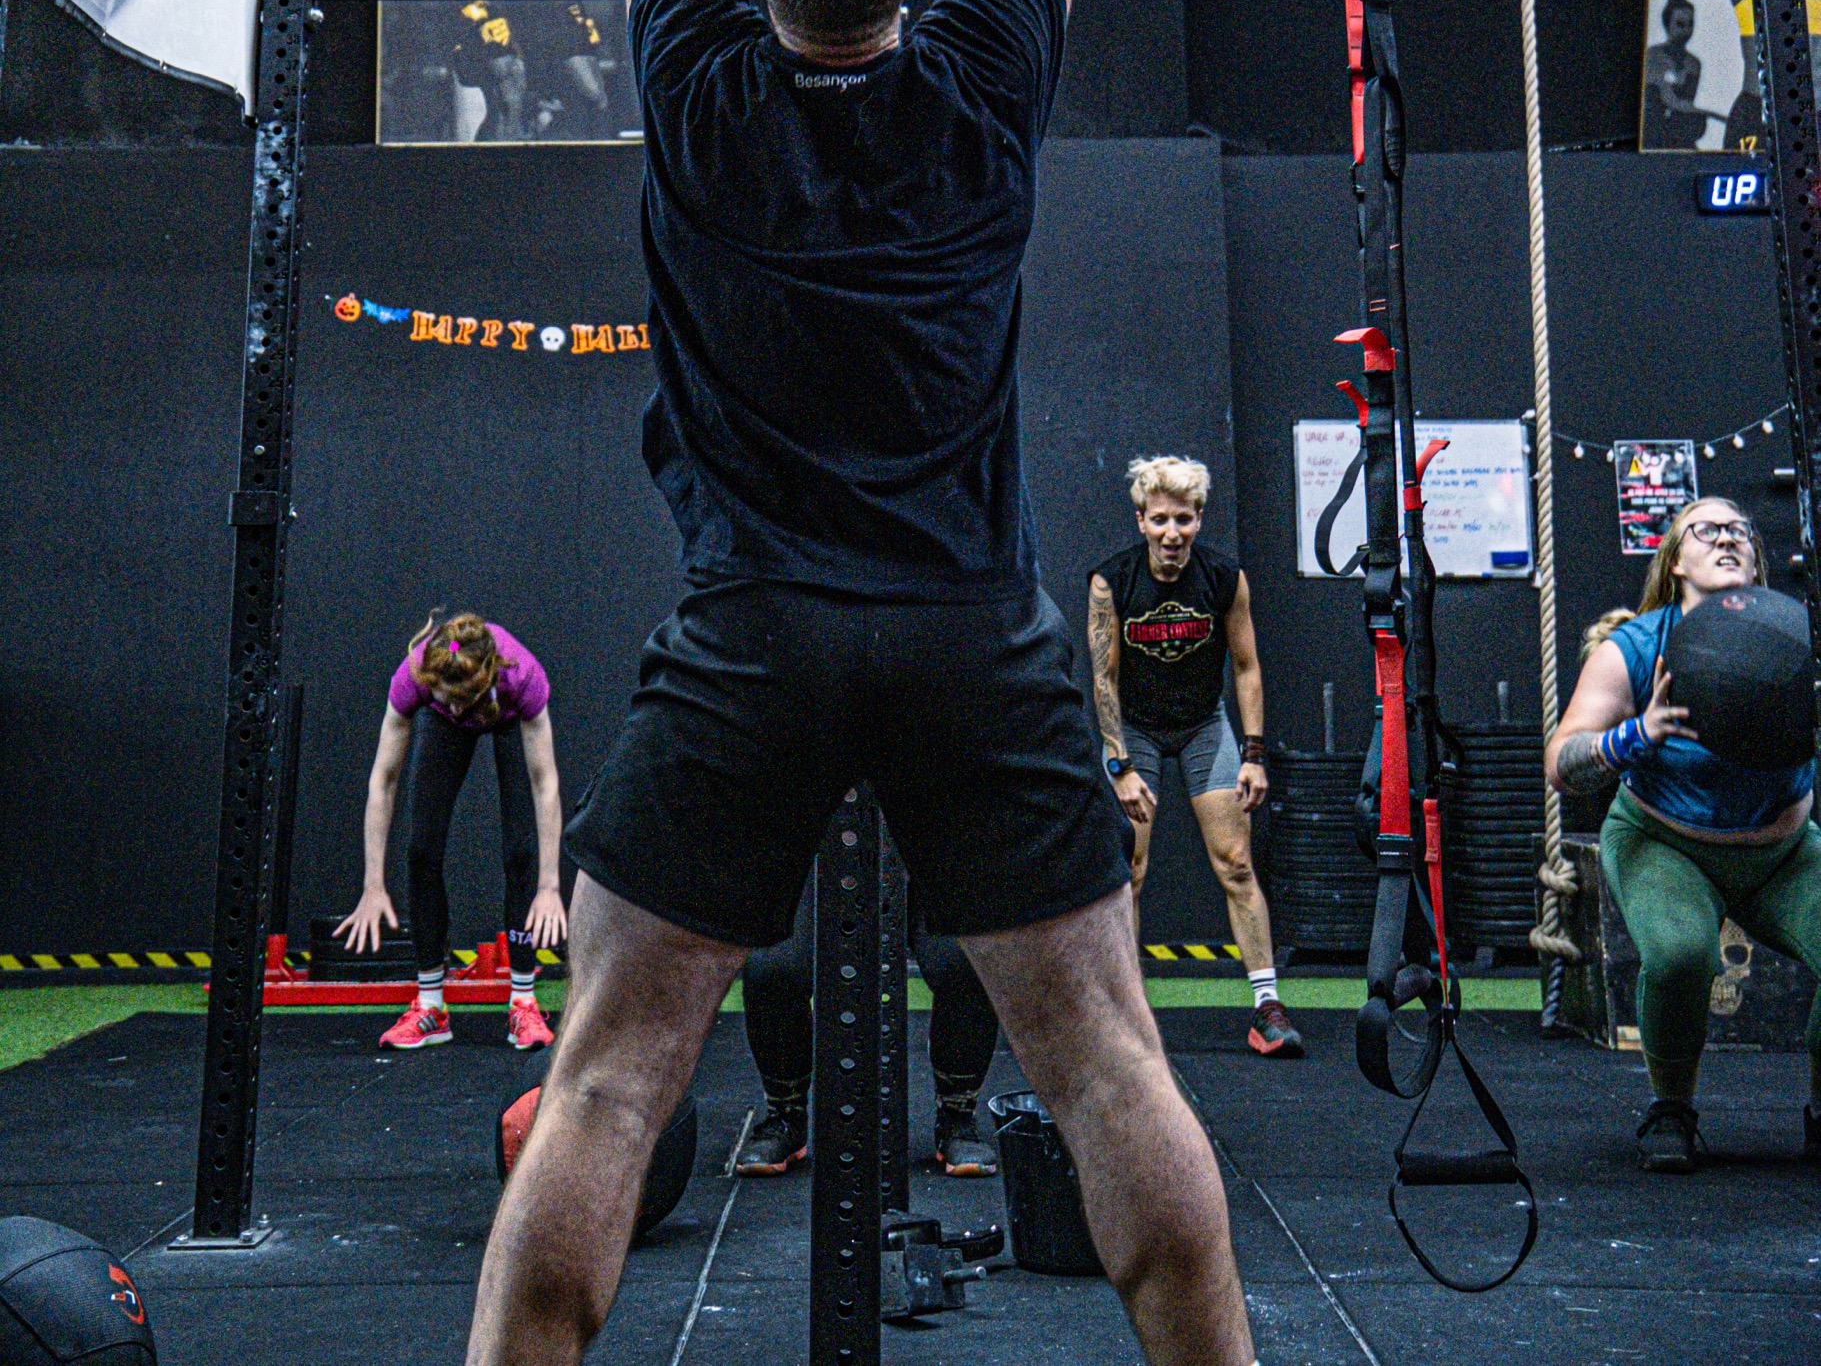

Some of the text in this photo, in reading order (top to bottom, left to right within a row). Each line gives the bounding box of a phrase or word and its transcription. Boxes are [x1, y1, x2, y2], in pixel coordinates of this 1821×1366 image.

[795, 72, 866, 92] Besançon
[1739, 136, 1758, 150] 17
[1711, 174, 1757, 207] UP
[411, 310, 535, 351] HAPPY
